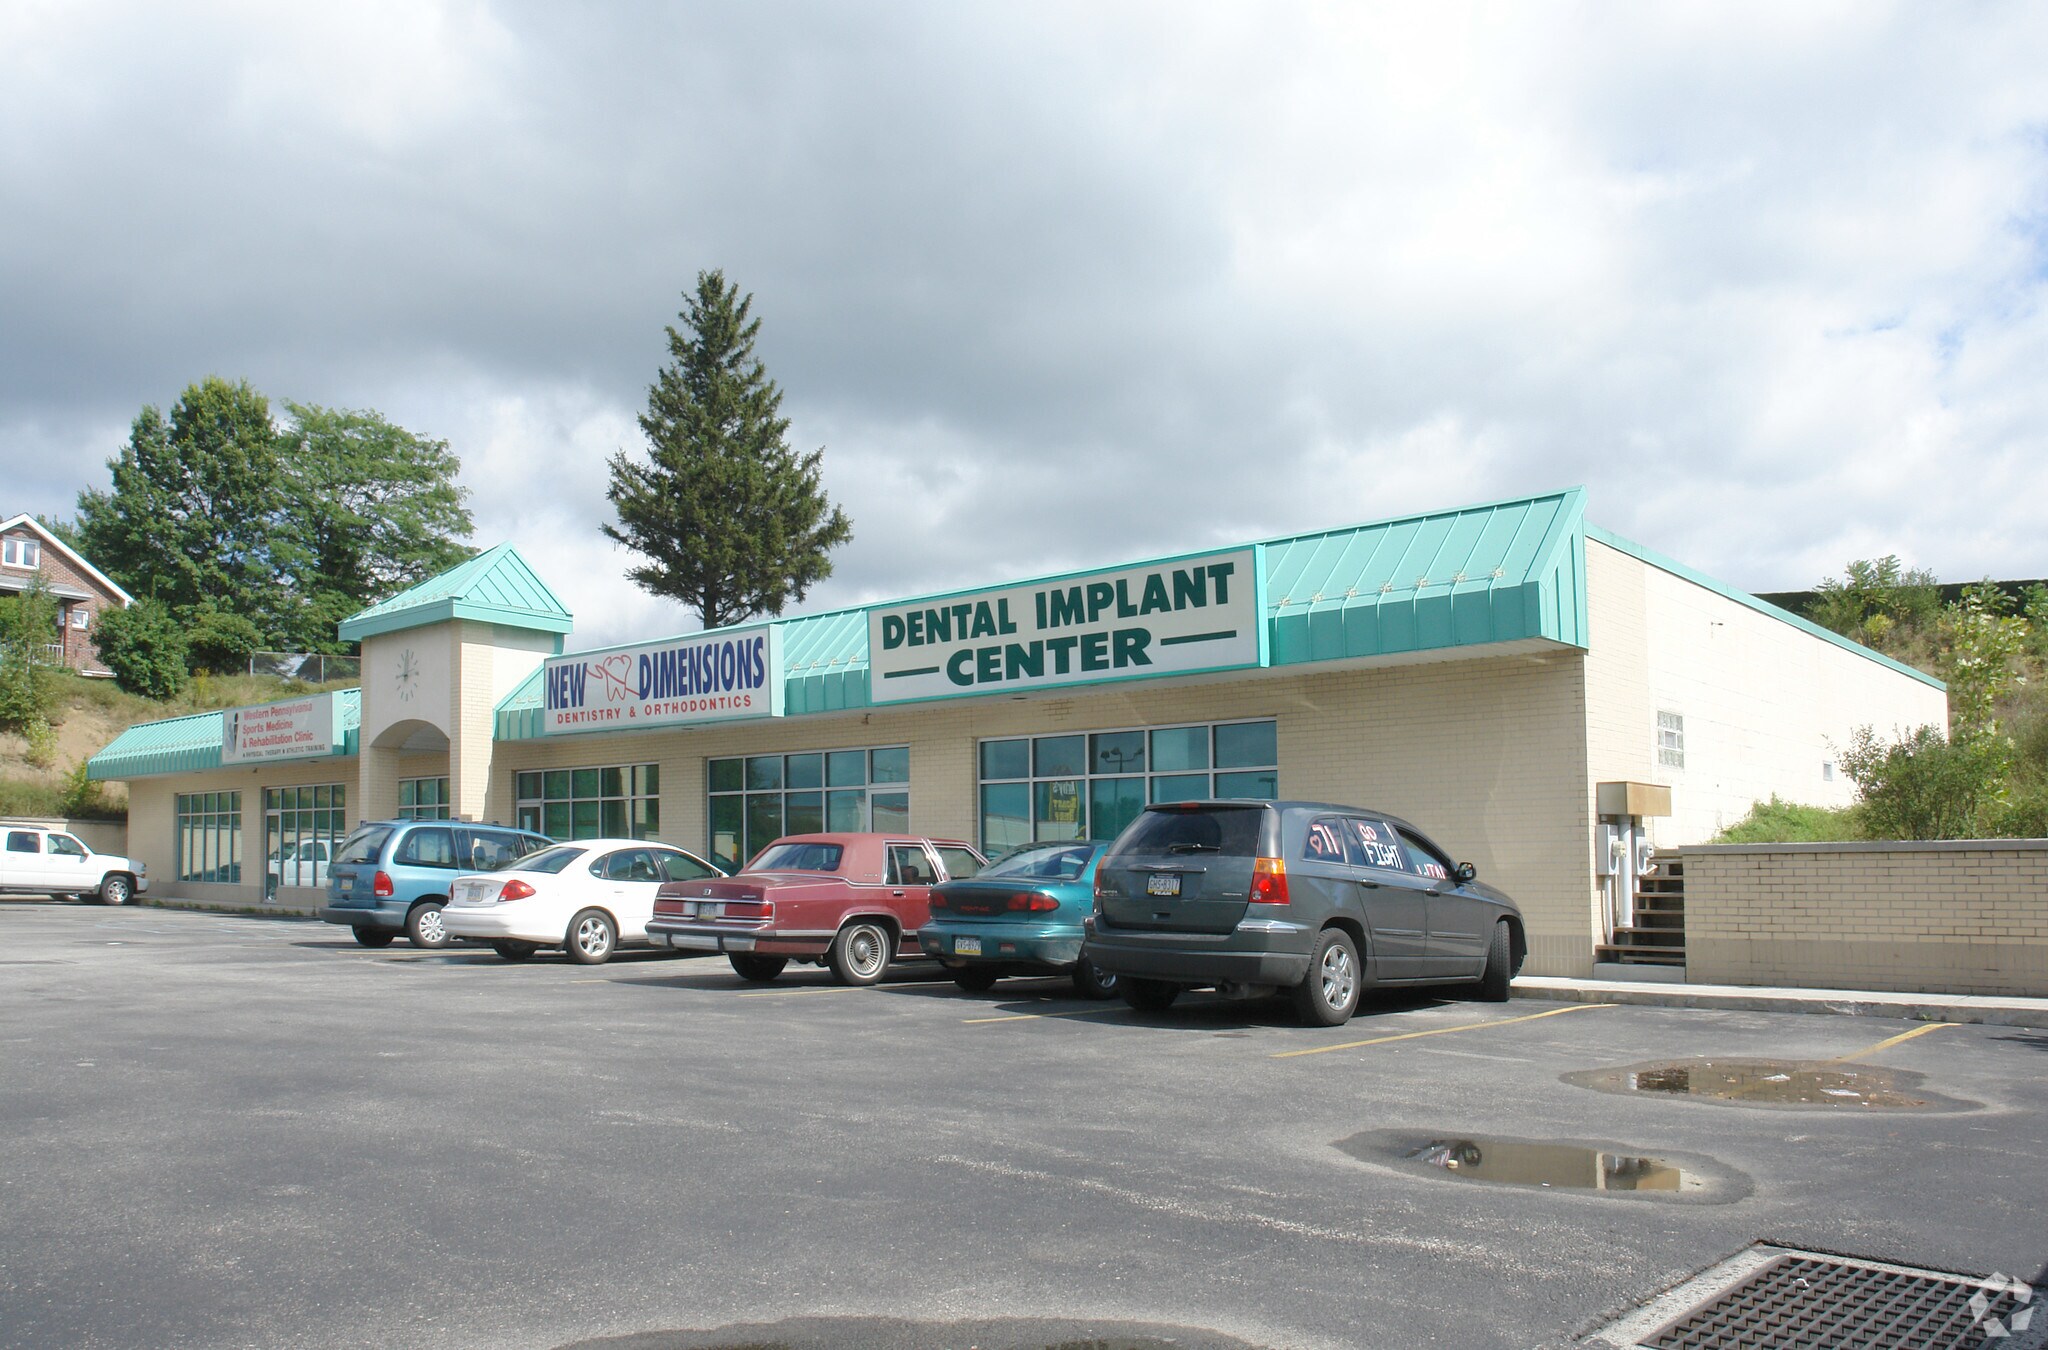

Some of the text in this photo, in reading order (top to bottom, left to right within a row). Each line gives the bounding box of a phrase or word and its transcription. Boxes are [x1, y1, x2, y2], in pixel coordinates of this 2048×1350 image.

[882, 562, 1234, 650] DENTAL IMPLANT
[946, 627, 1153, 686] CENTER
[548, 636, 765, 710] NEW DIMENSIONS
[244, 702, 313, 720] Western Pennsylvania
[557, 694, 752, 724] DENTISTRY & ORTHODONTICS
[242, 719, 293, 735] Sports Medicine
[249, 733, 293, 747] Rehabilitation
[294, 730, 313, 742] Clinic
[1358, 823, 1377, 841] GO
[1363, 841, 1403, 869] FIGHT
